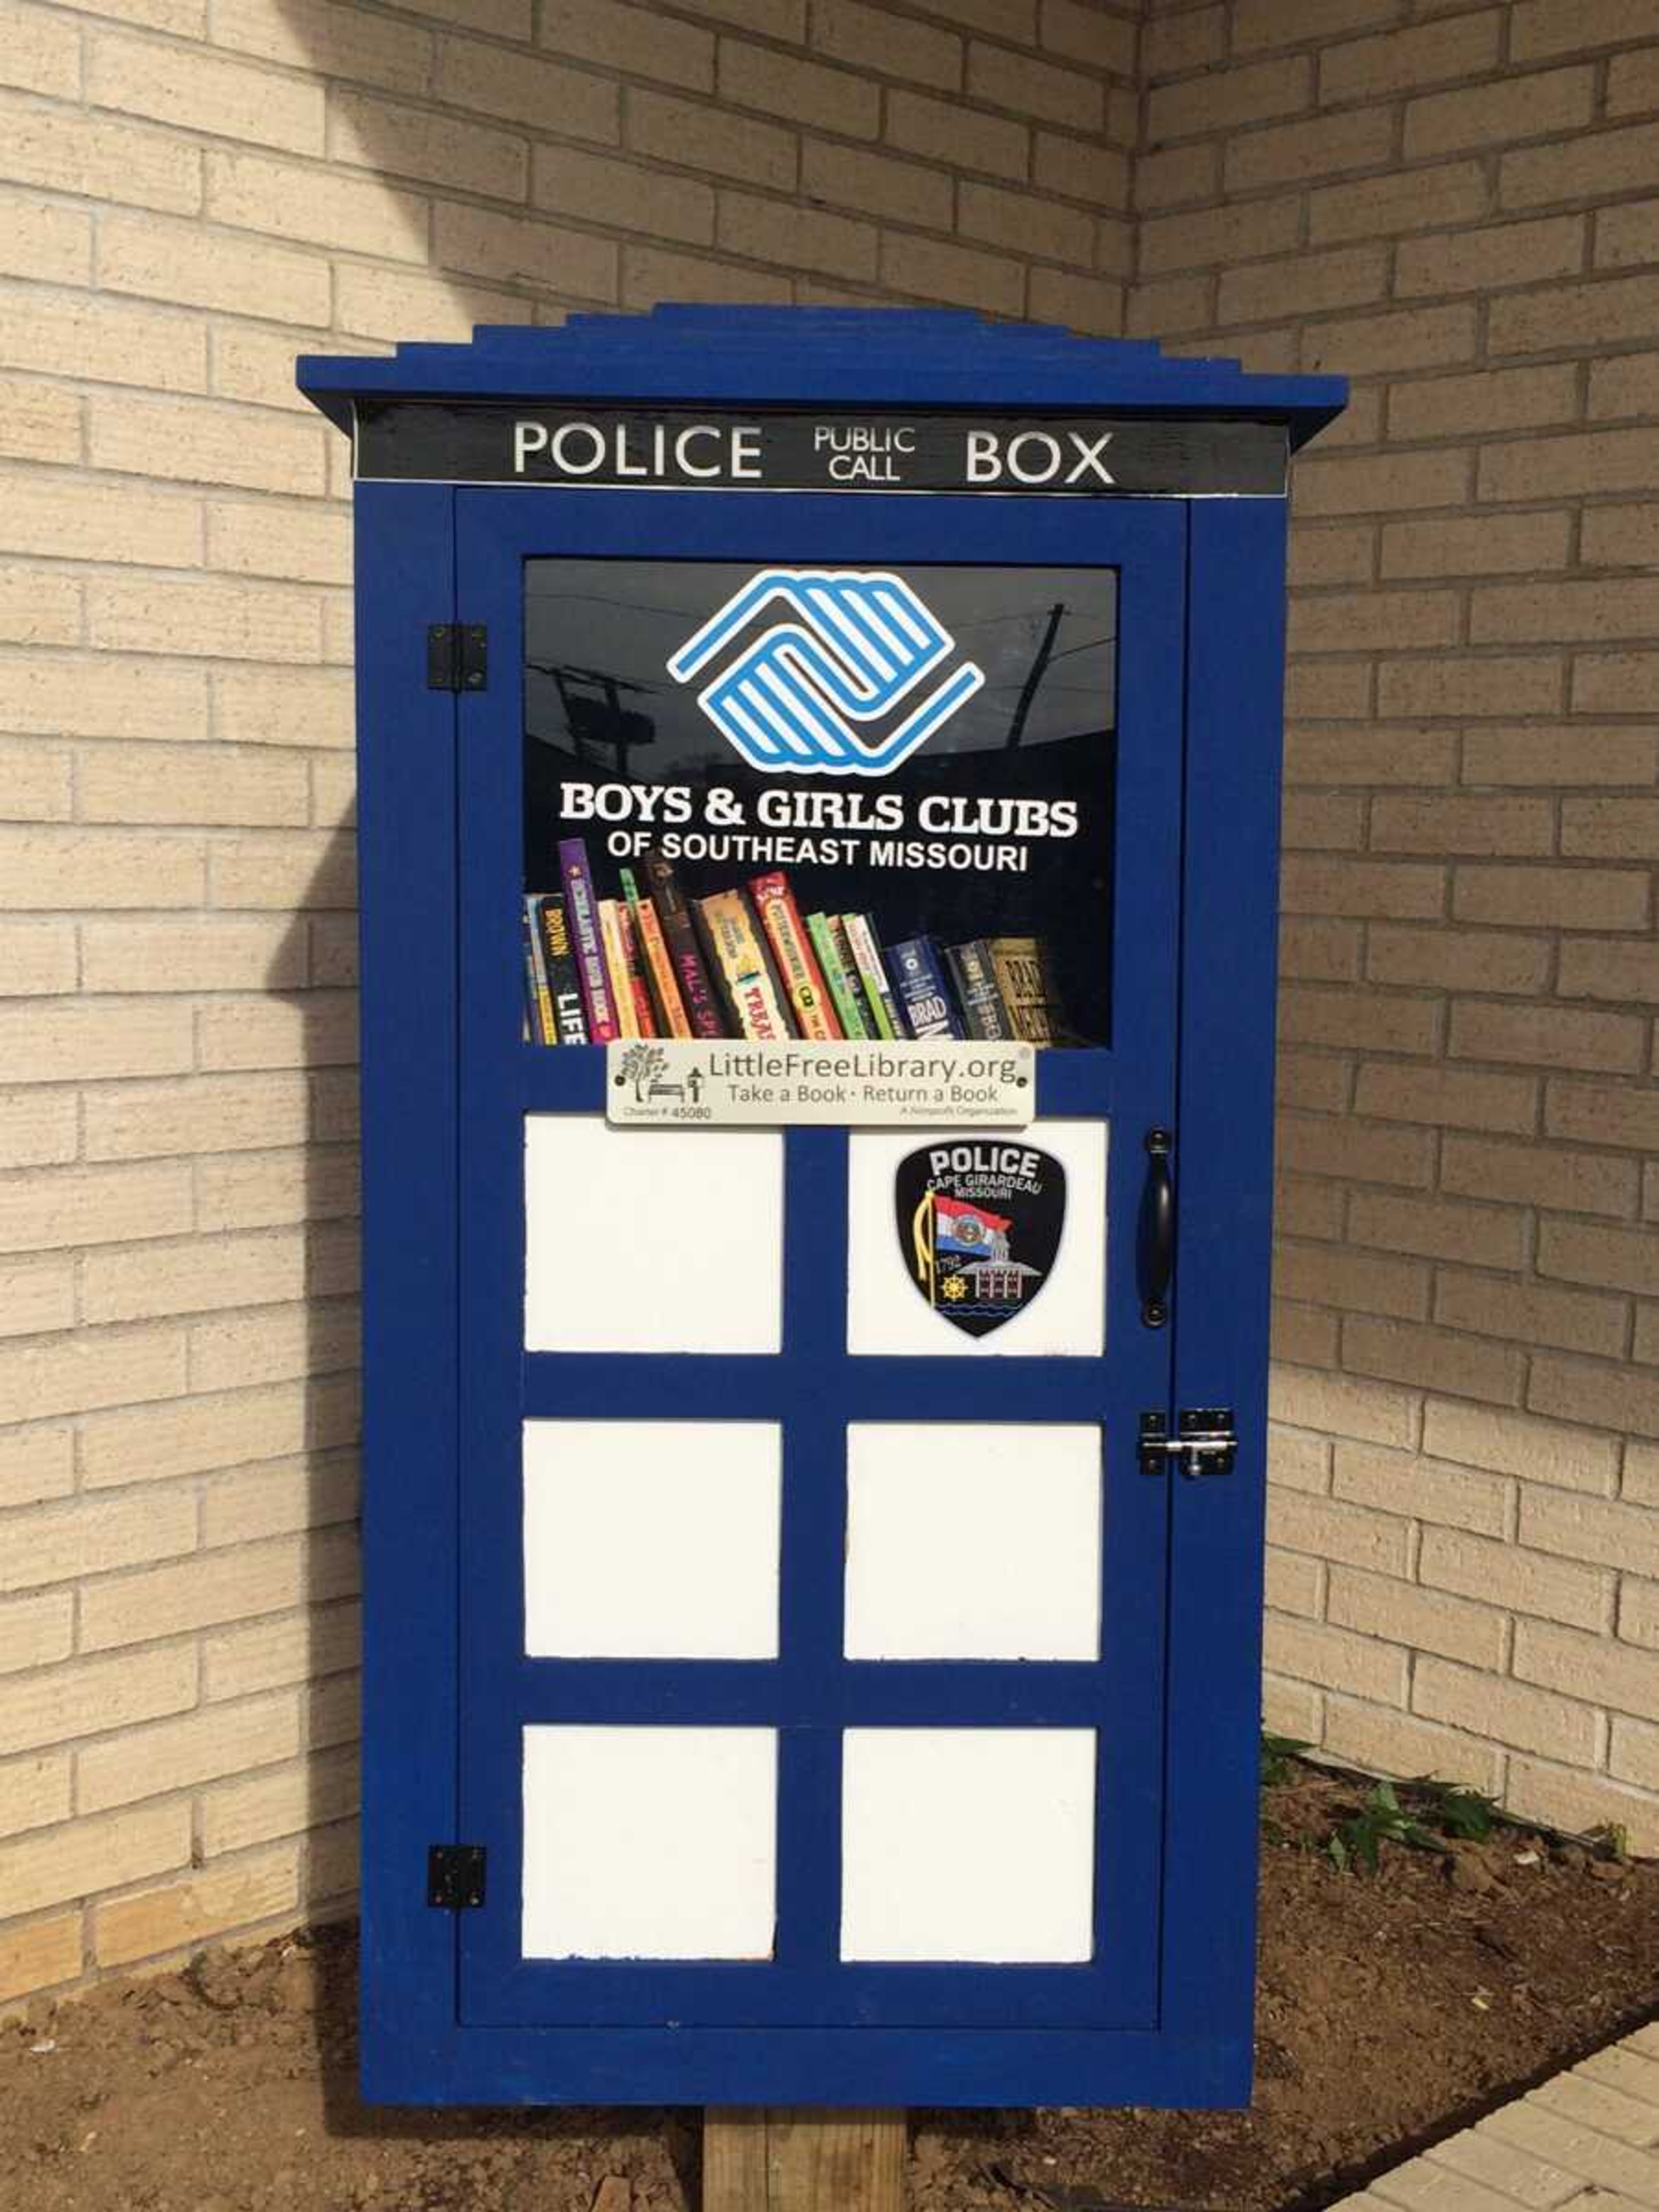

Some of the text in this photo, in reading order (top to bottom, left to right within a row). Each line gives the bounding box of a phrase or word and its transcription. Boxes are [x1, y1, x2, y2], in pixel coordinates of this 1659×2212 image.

[515, 423, 762, 478] POLICE
[815, 427, 915, 452] PUBLIC
[829, 455, 901, 481] CALL
[966, 431, 1115, 484] BOX
[559, 782, 1078, 838] BOYS & GIRLS CLUBS
[608, 831, 1027, 871] OF SOUTHEAST MISSOURI
[556, 993, 586, 1045] LIFE
[710, 1052, 1016, 1084] LittleFreeLibrary.org
[728, 1084, 998, 1102] Take a Book Return a Book
[929, 1146, 1040, 1178] POLICE
[927, 1174, 1042, 1195] CAPE GIRARDEAU
[954, 1186, 1013, 1199] MISSOURI
